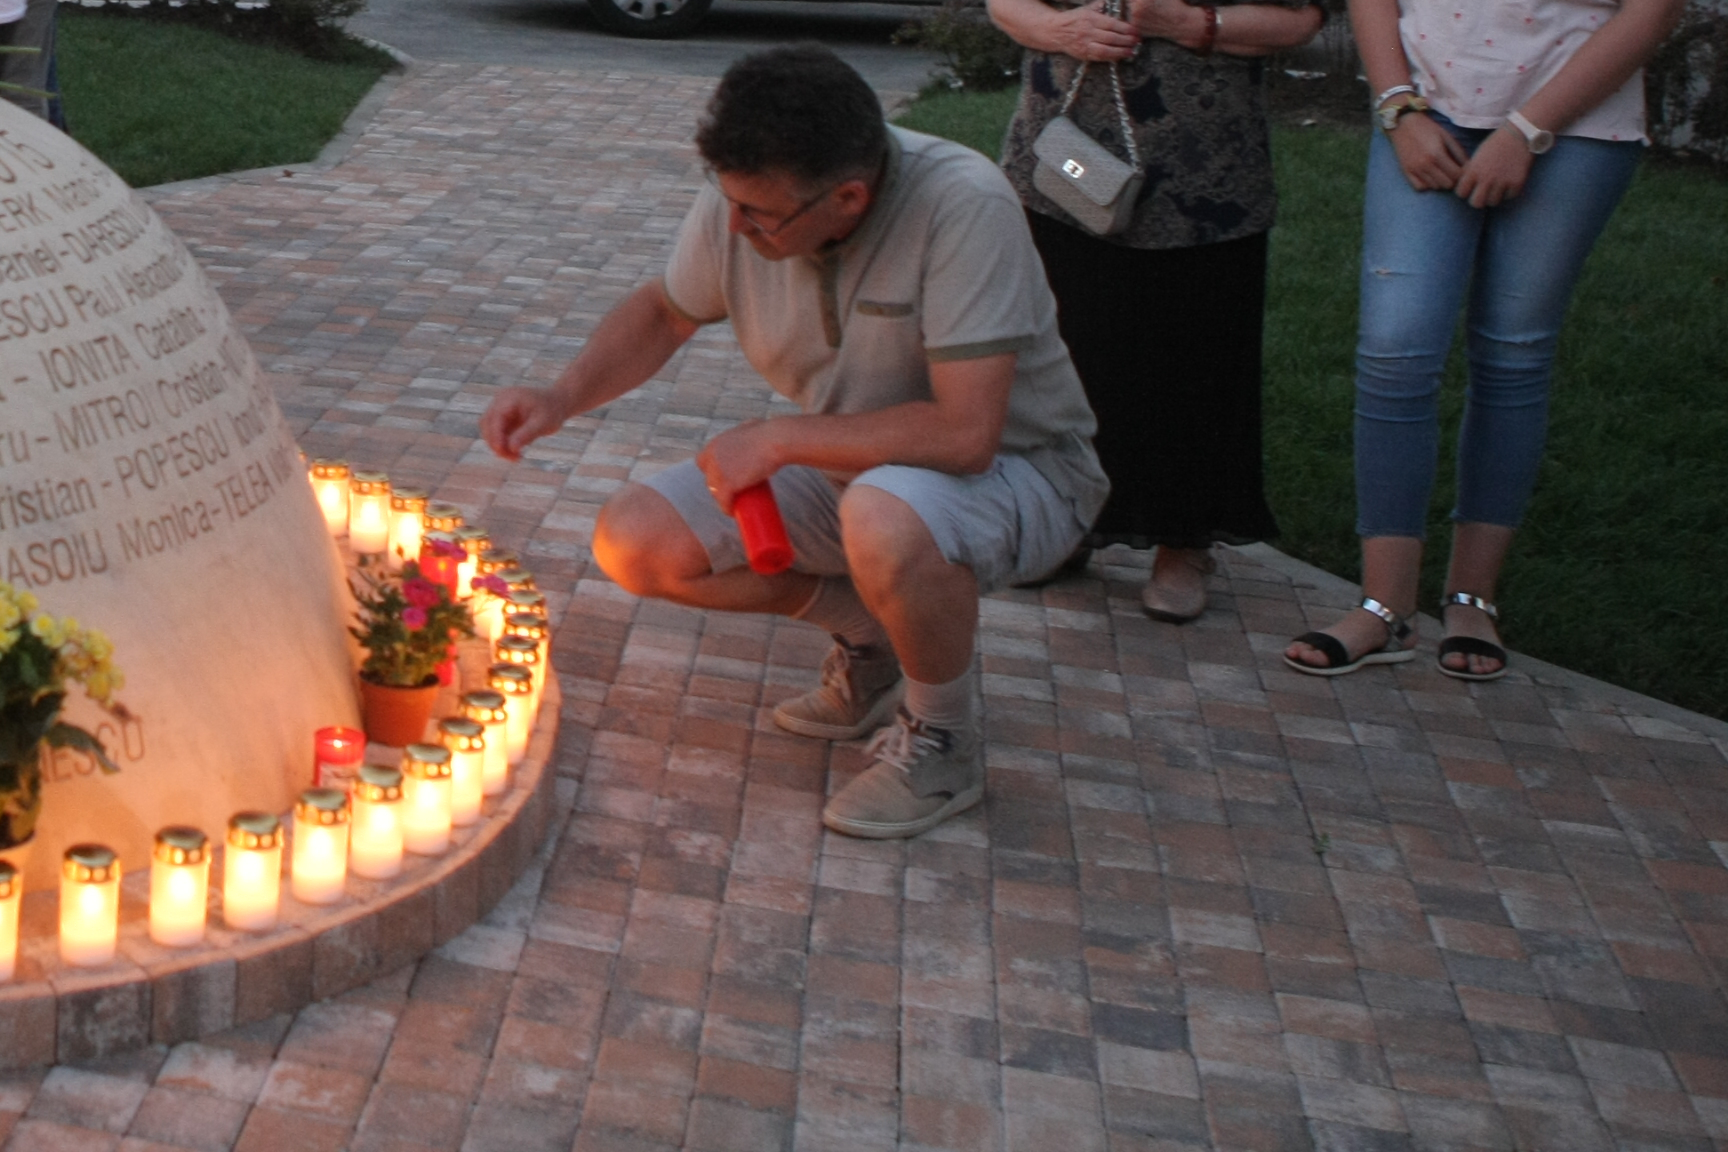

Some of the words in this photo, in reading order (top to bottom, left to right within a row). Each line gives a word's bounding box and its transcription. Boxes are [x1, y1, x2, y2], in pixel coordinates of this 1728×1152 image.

[38, 333, 141, 394] IONITA
[53, 384, 160, 453] MITROI
[114, 417, 230, 499] POPESCU
